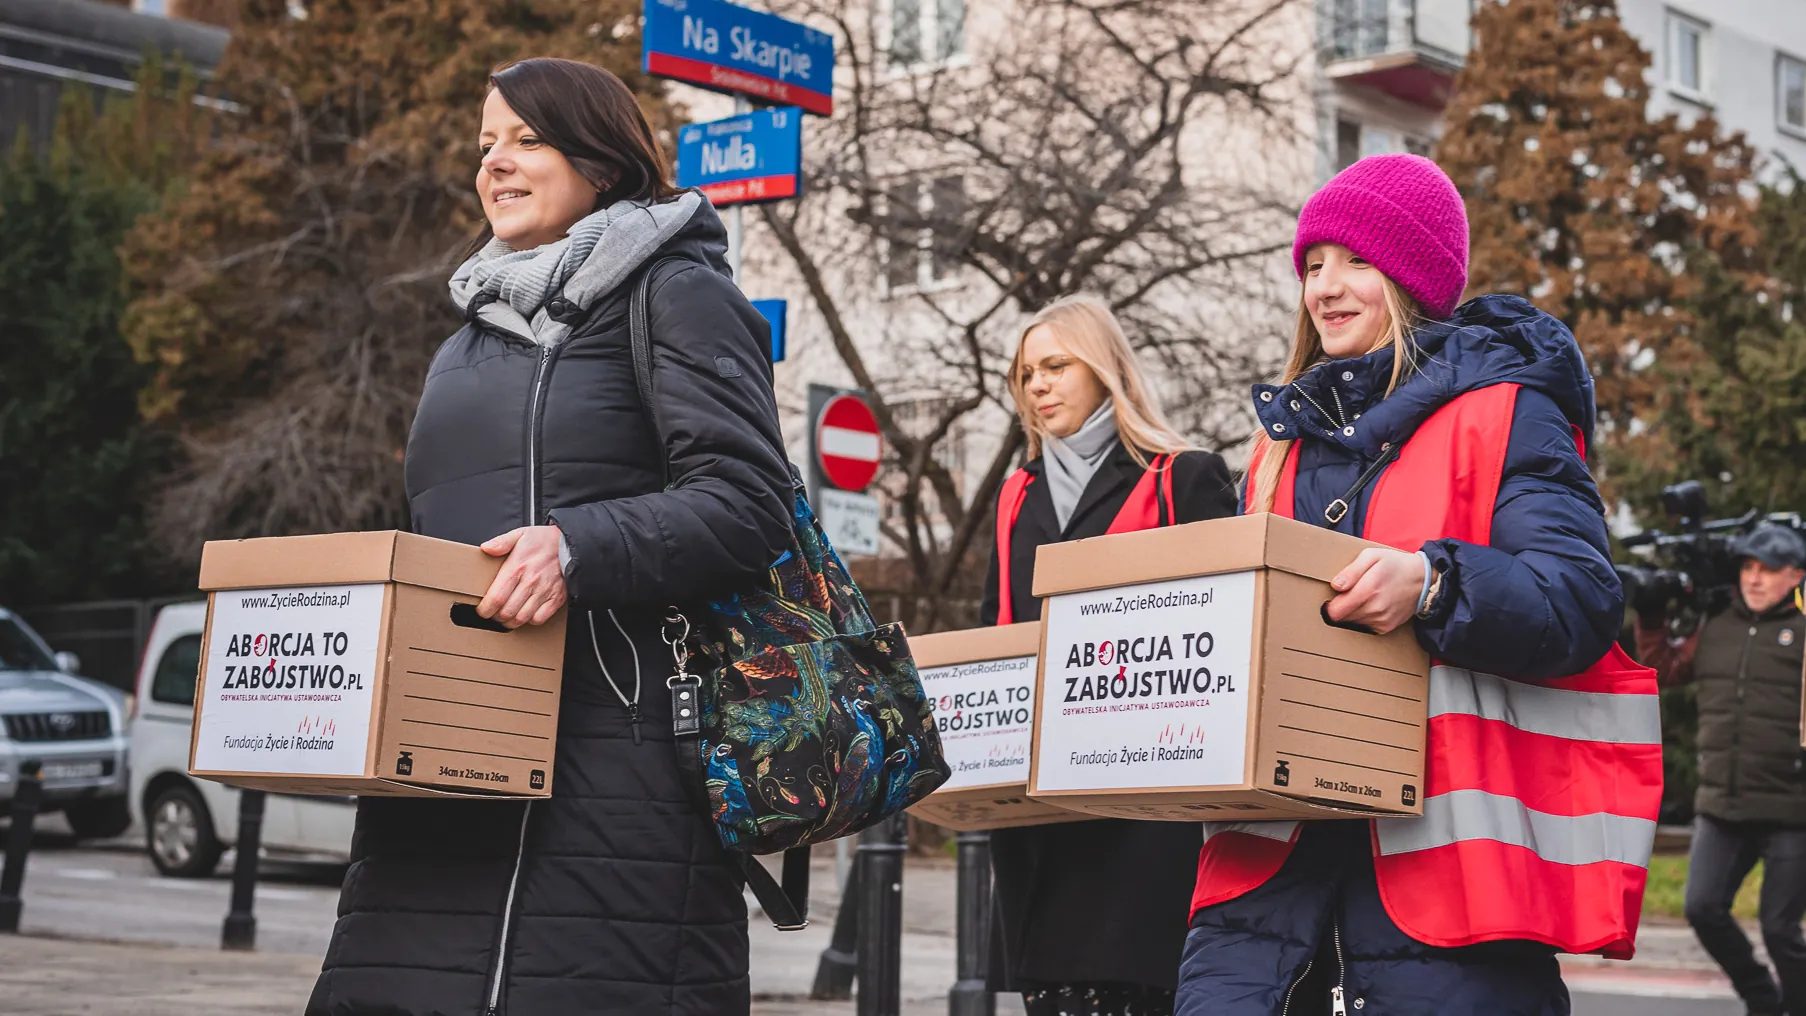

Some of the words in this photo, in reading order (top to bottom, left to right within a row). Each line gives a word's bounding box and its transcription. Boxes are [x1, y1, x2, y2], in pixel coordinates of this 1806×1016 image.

[683, 15, 719, 54] Na
[730, 26, 812, 80] Skarpie
[701, 136, 756, 176] Nulla
[242, 591, 351, 610] www.ZycieRodzina.pl
[1080, 588, 1213, 616] www.ZycieRodzina.pl
[226, 633, 315, 657] ABORCJA
[323, 632, 348, 656] TO
[1065, 636, 1173, 668] ABORCJA
[1183, 631, 1214, 658] TO
[222, 658, 363, 690] ZABÓJSTWO.PL
[924, 659, 1029, 680] www.ZycieRodzina.pl
[1063, 666, 1235, 702] ZABÓJSTWO.PL
[928, 690, 999, 712] BORCJA
[1006, 686, 1030, 703] TO
[1062, 706, 1108, 716] OBYWATELSKA
[1109, 703, 1149, 712] INICJATYWA
[1151, 699, 1210, 709] USTAWODAWCZA
[223, 735, 264, 751] Fundacja
[265, 733, 288, 751] Życie
[290, 736, 295, 749] i
[296, 736, 334, 750] Rodzina
[958, 757, 981, 772] Życie
[988, 757, 1024, 768] Rodzina
[1070, 750, 1117, 766] Fundacja
[1120, 746, 1148, 765] Życie
[1151, 747, 1156, 761] i
[1157, 745, 1204, 761] Rodzina
[438, 766, 458, 777] 34cm
[459, 770, 464, 778] x
[465, 768, 484, 780] 25cm
[491, 772, 509, 783] 26cm
[531, 774, 543, 785] 22L
[1314, 777, 1333, 789] 34cm
[1334, 783, 1339, 791] x
[1339, 782, 1358, 794] 25cm
[1359, 787, 1363, 795] x
[1364, 785, 1382, 798] 26cm
